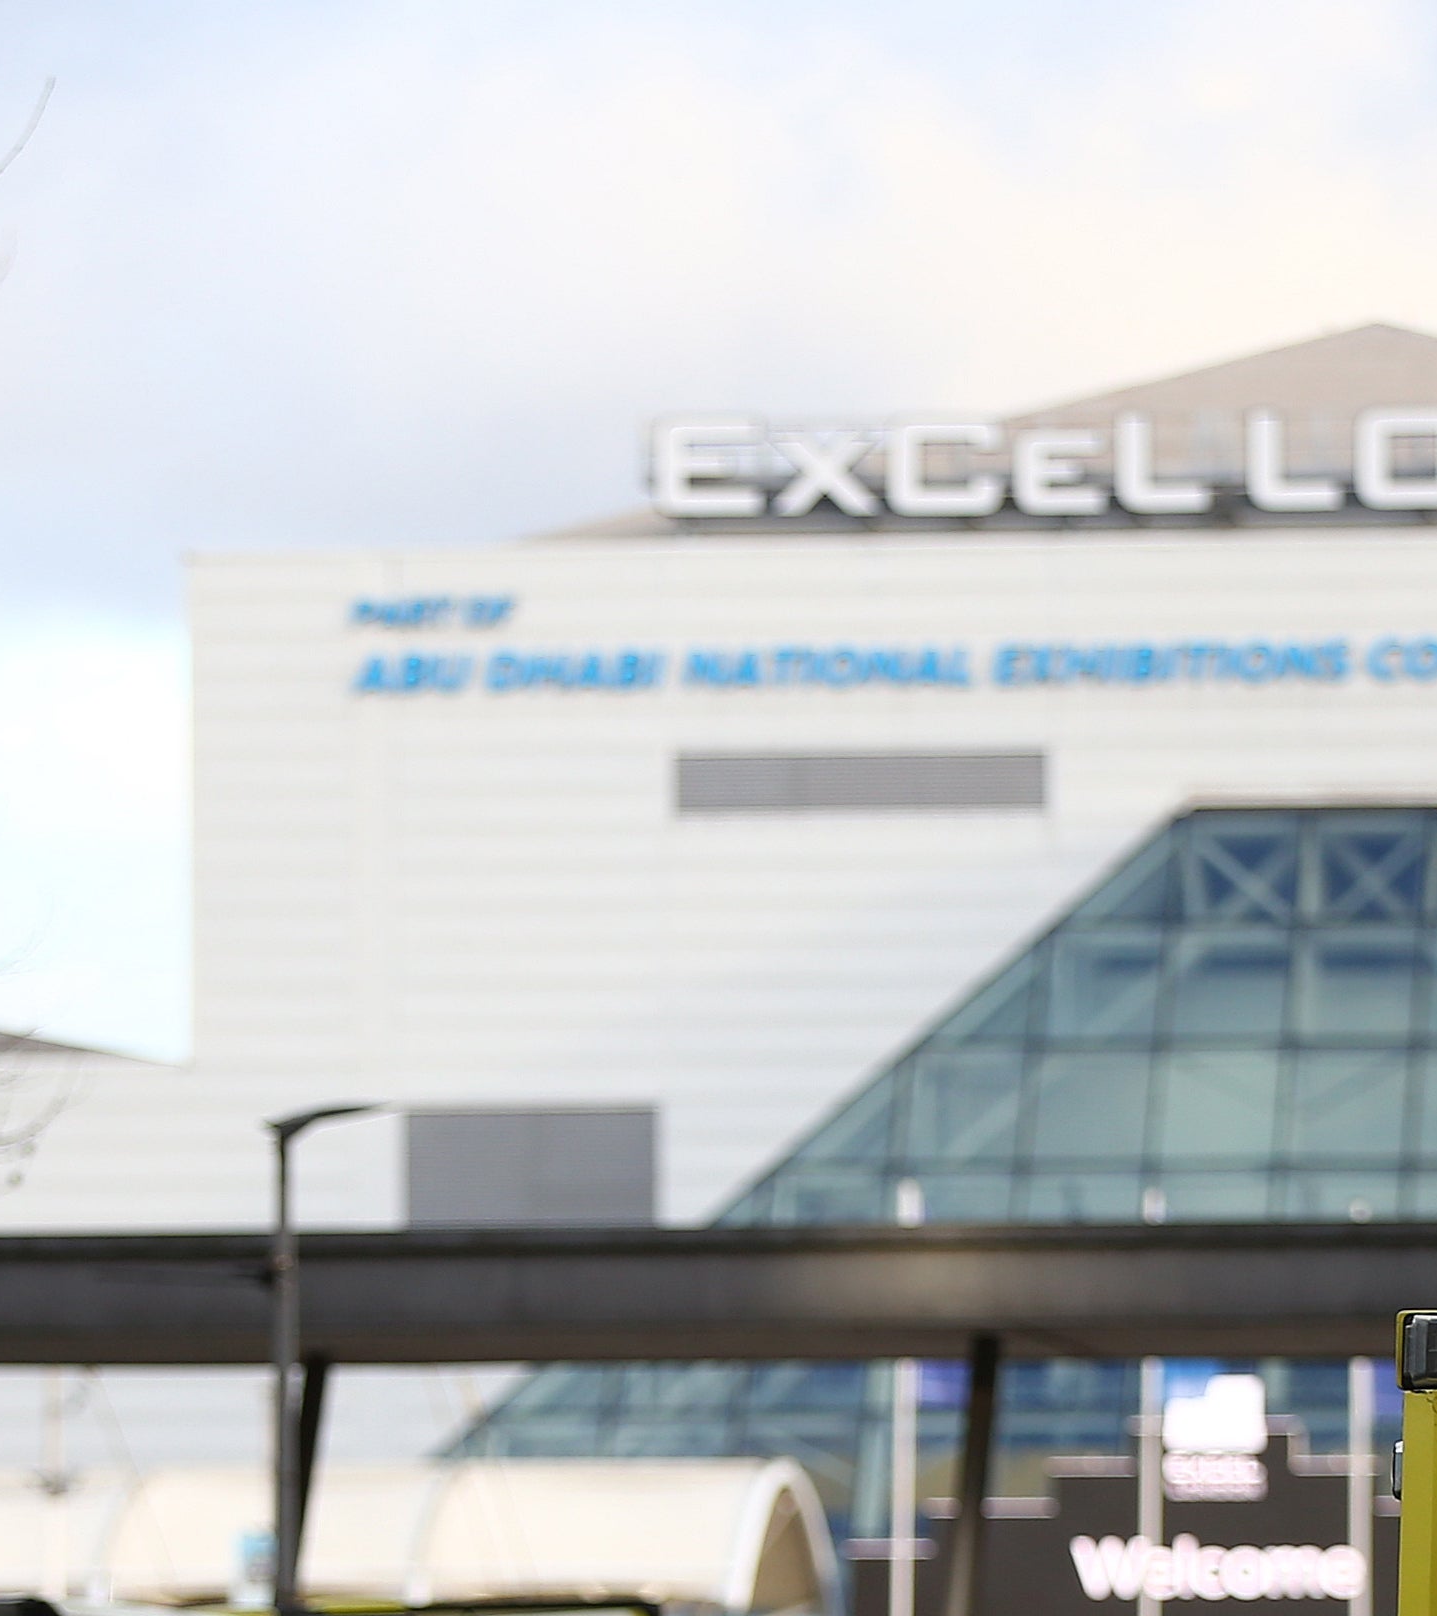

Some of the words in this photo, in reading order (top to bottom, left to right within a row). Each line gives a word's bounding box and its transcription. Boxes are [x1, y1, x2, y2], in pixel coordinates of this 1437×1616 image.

[354, 651, 463, 694] ABU
[485, 650, 660, 691] DHABI
[679, 645, 969, 690] NATIONAL
[994, 640, 1348, 687] EXHIBITIONS
[1070, 1533, 1365, 1601] Welcome
